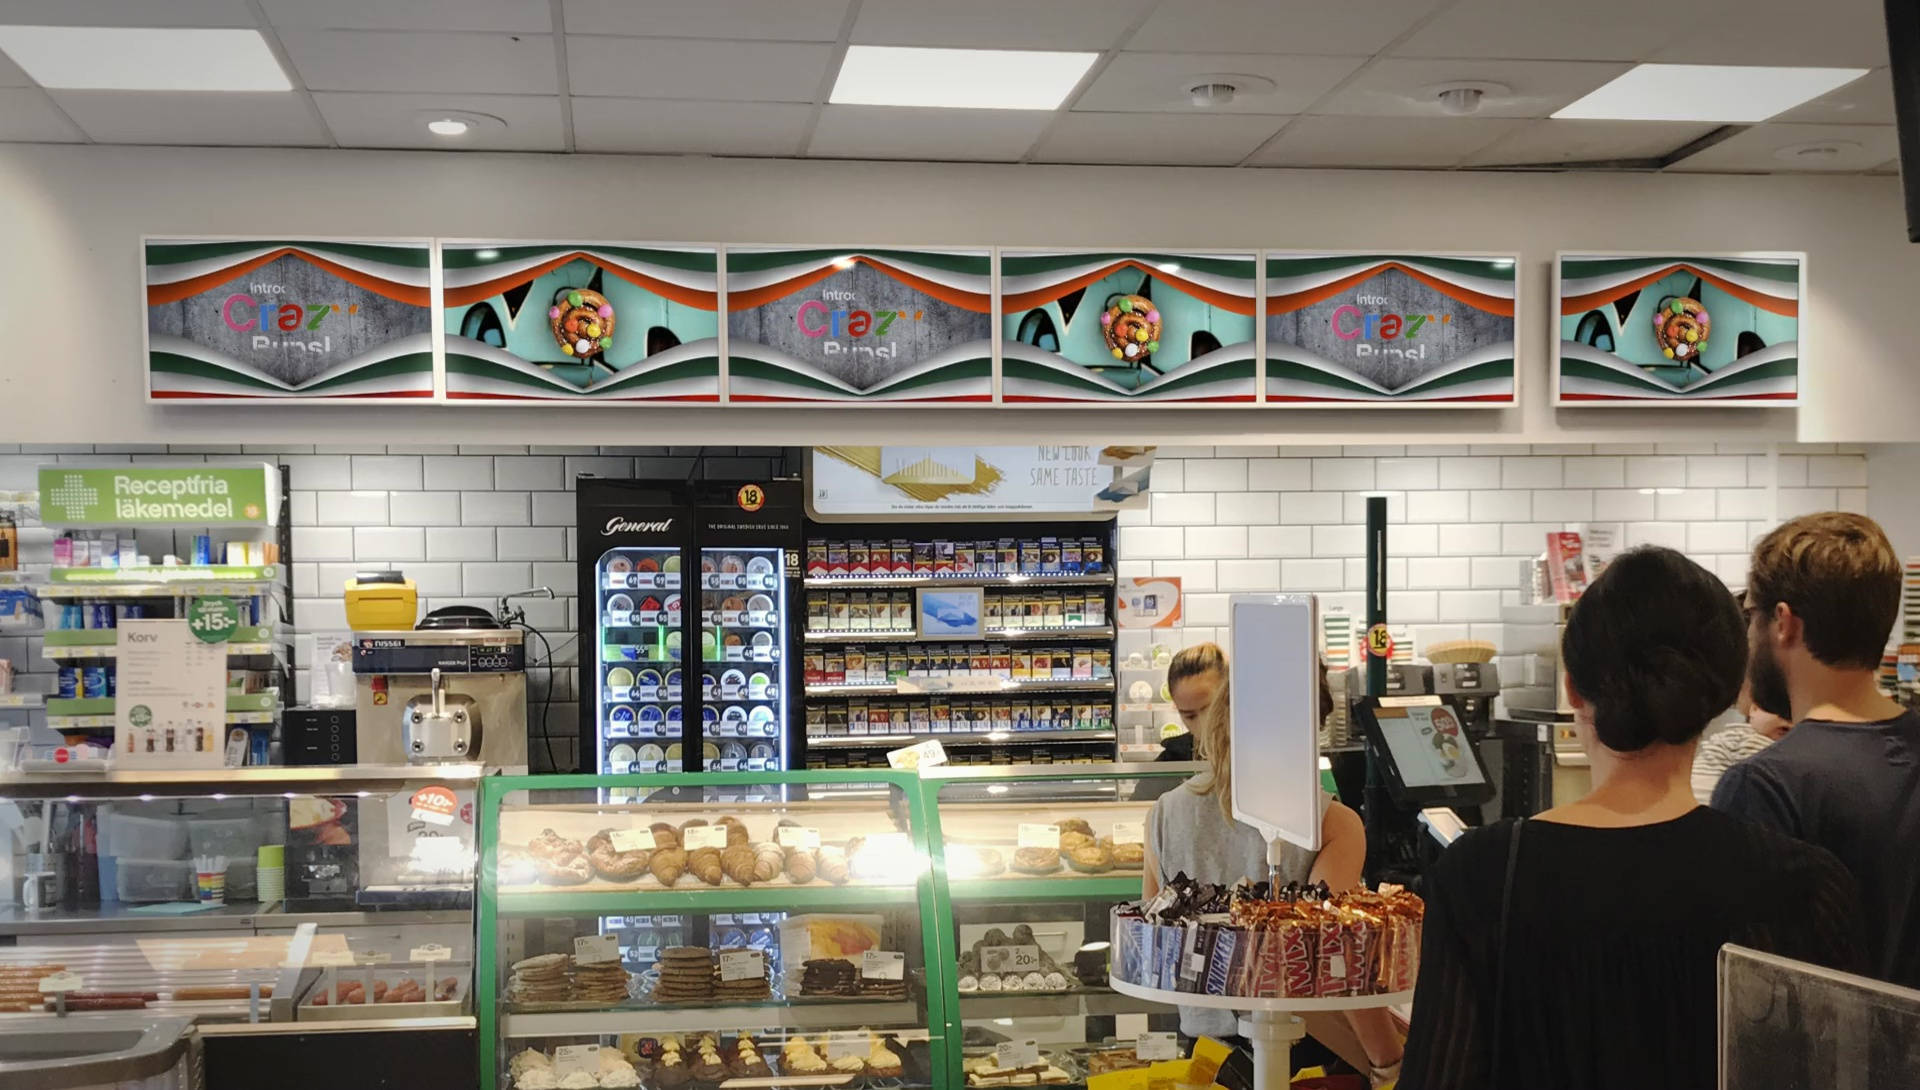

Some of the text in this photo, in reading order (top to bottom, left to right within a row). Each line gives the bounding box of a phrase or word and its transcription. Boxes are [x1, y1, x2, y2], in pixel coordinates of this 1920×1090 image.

[1030, 467, 1097, 487] SAME TASTE
[114, 475, 229, 500] Receptfria
[744, 489, 758, 503] 18
[115, 497, 233, 519] läkemedel
[600, 516, 675, 536] General
[784, 553, 799, 567] 18
[127, 632, 159, 643] Korv
